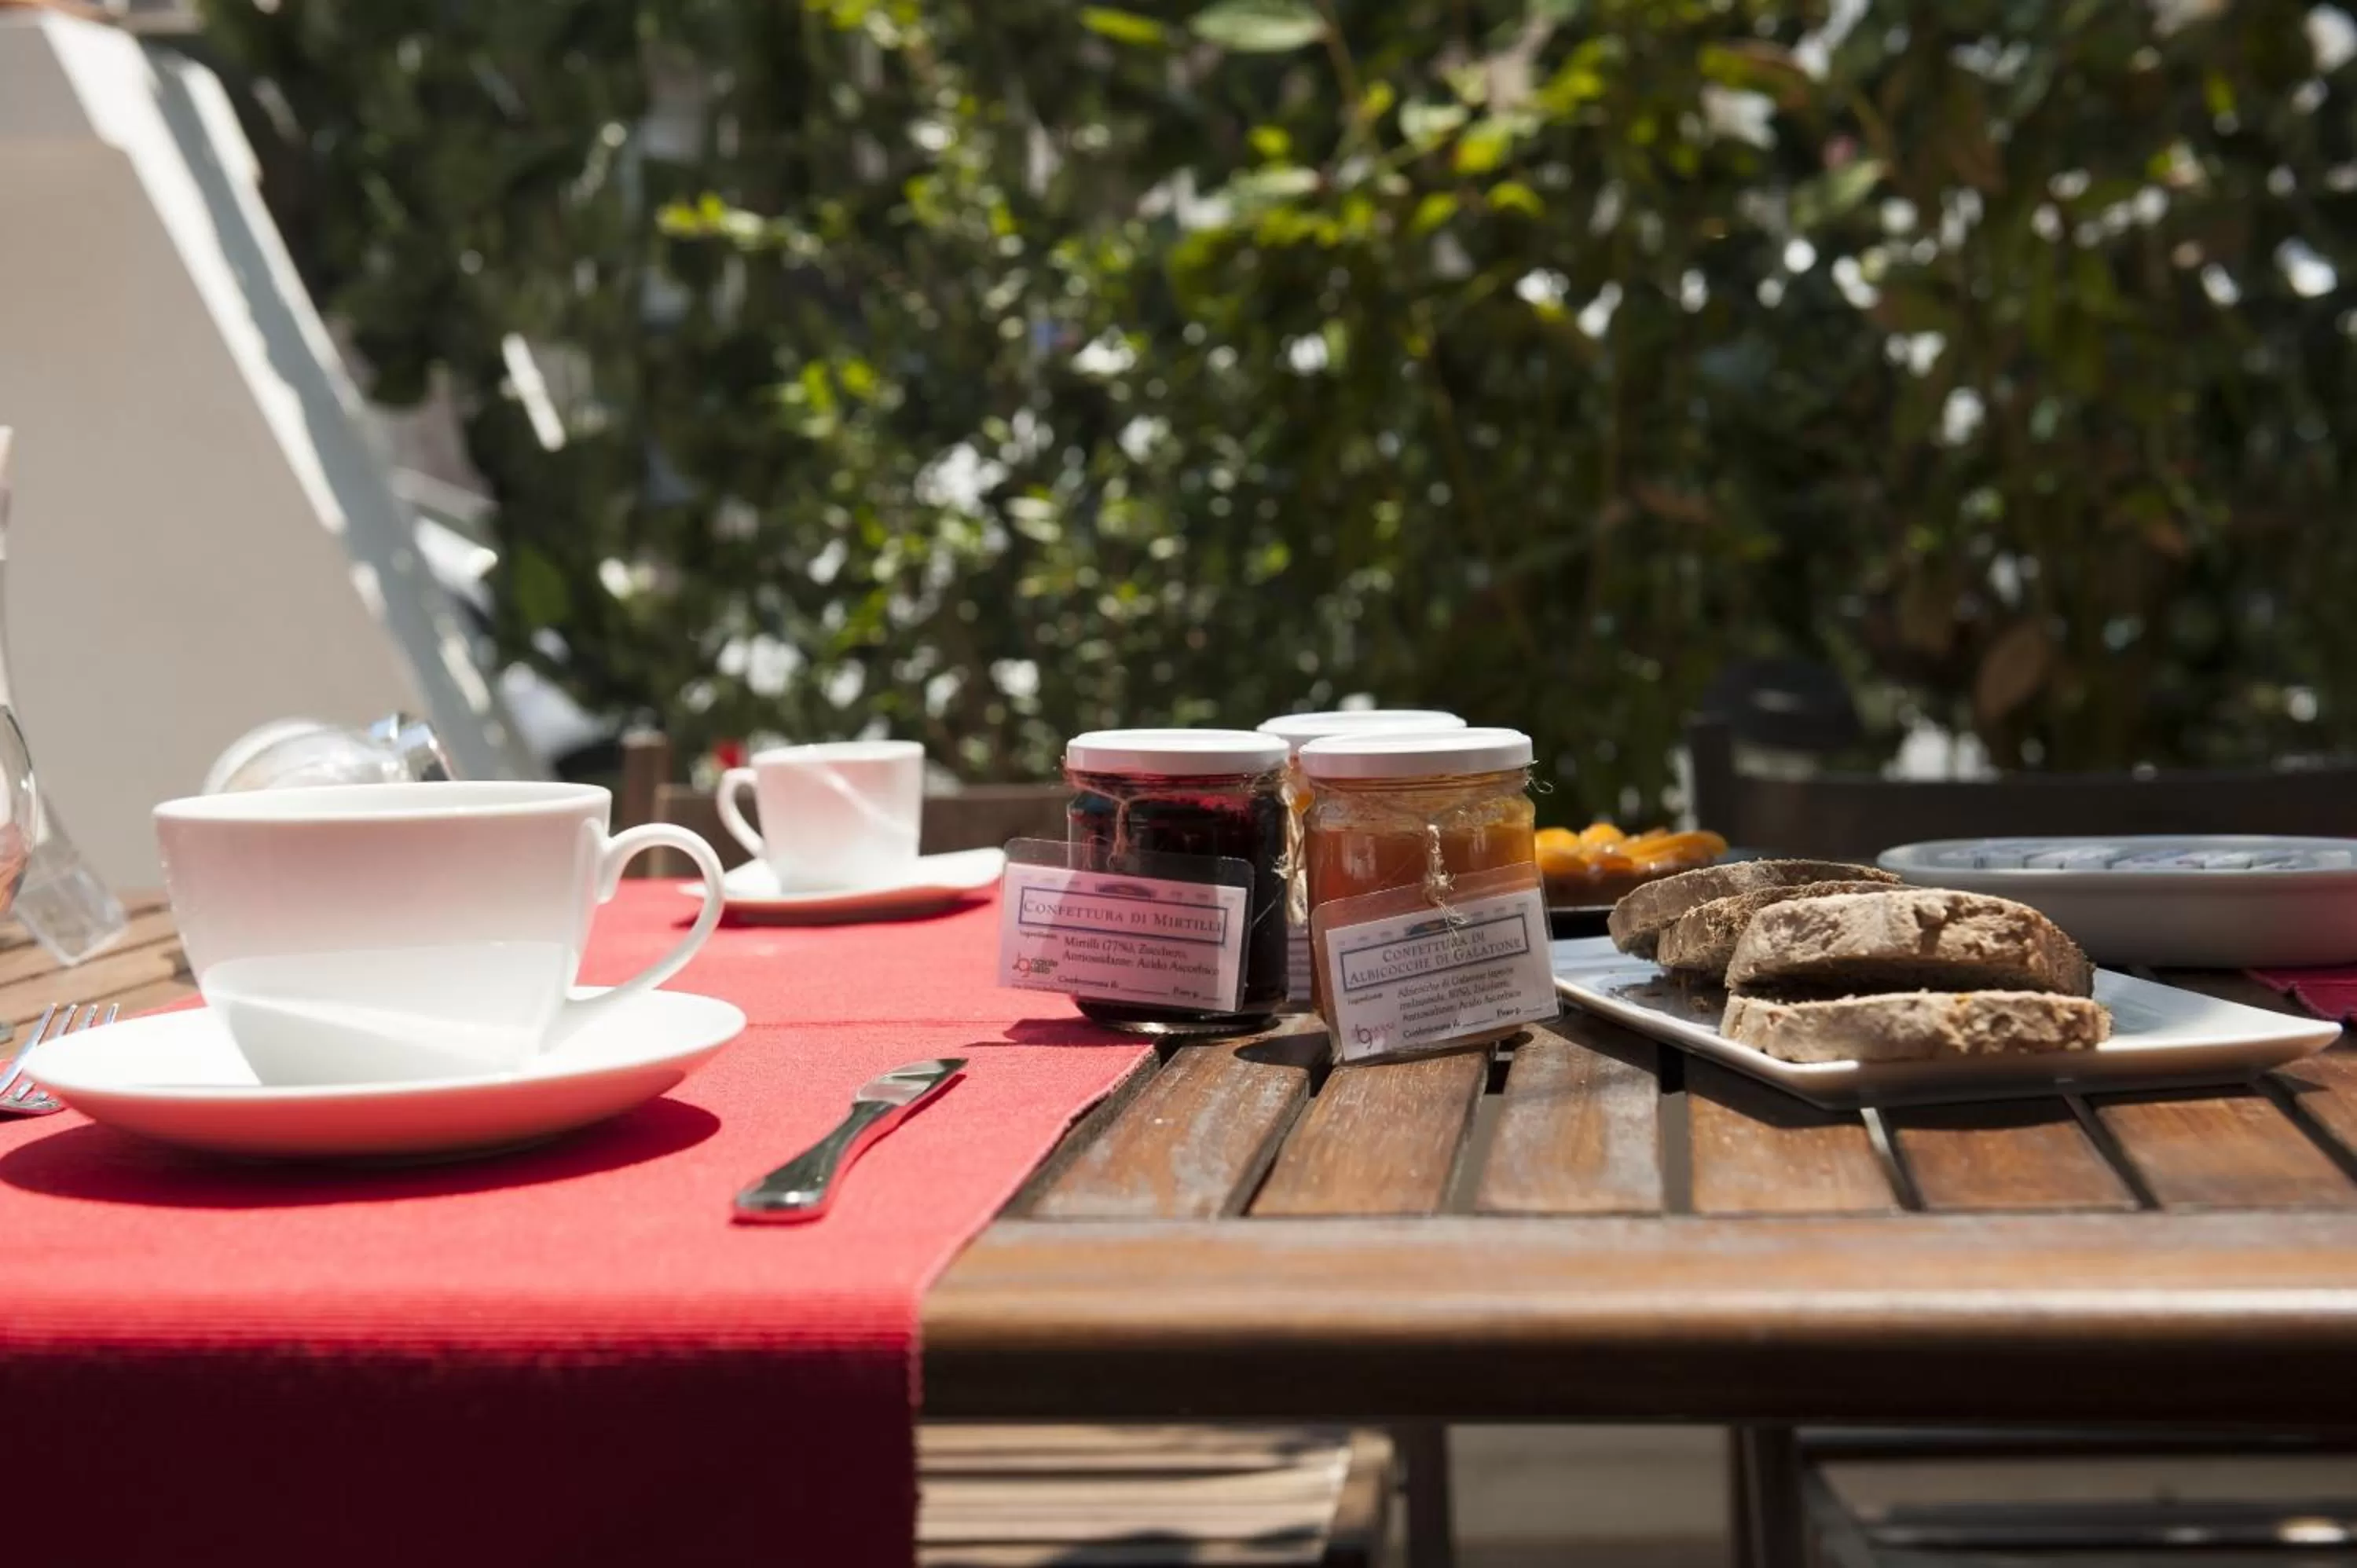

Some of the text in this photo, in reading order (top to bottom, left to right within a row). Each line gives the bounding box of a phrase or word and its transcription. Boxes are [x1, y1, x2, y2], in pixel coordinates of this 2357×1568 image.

[1024, 900, 1221, 932] CONFETTURA DI MIRTILLI
[1351, 938, 1522, 984] ALBICOCCHE DI GALATONE
